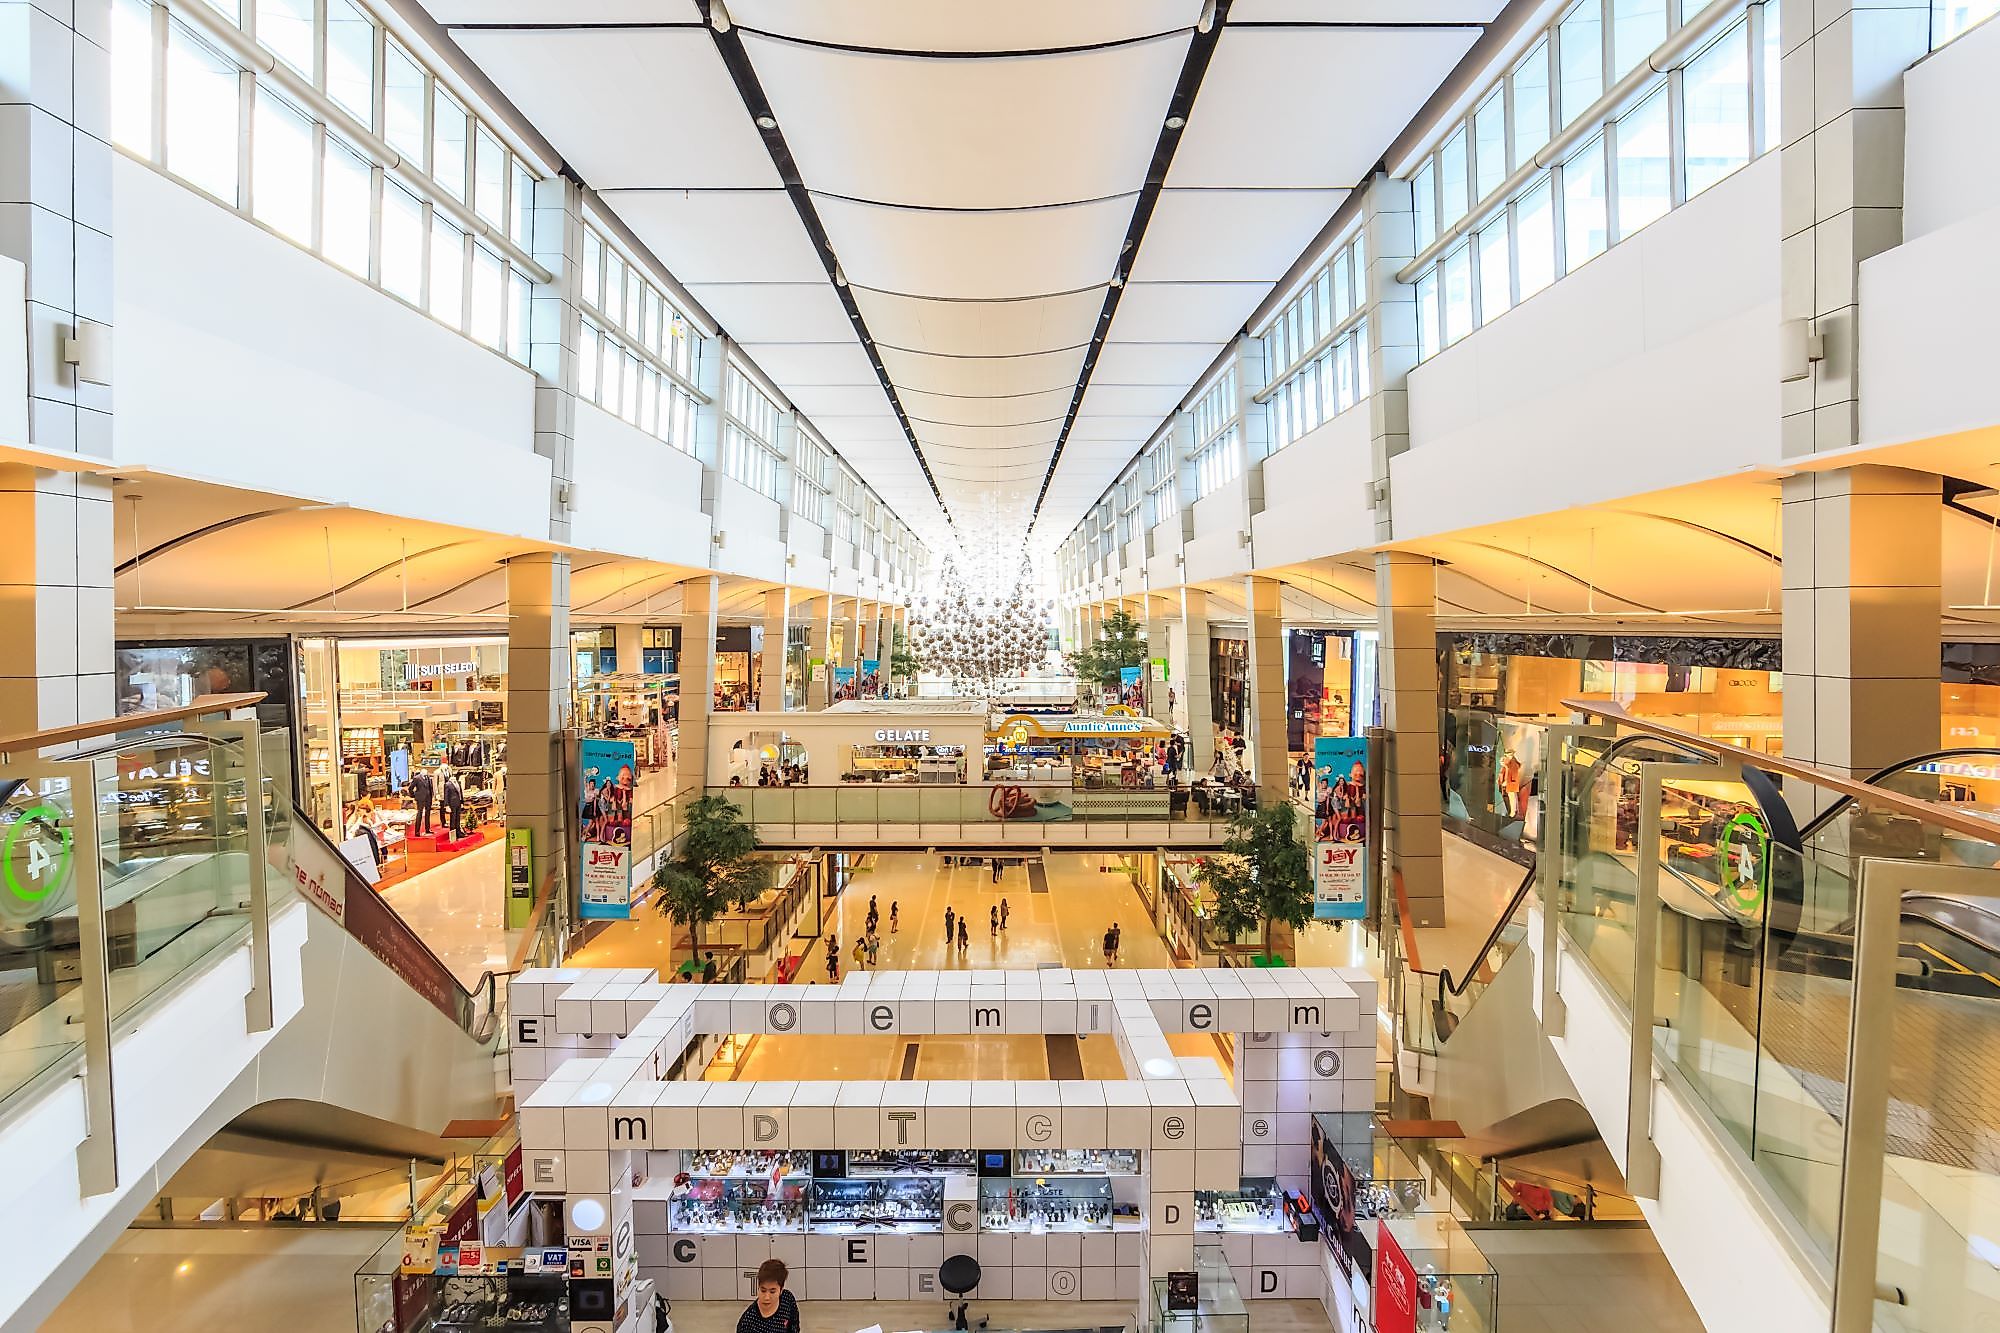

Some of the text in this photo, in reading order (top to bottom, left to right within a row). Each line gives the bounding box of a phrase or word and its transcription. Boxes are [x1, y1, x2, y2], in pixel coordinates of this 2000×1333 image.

[421, 665, 443, 676] SUIT
[875, 730, 930, 741] GELATE
[1065, 721, 1141, 731] Auntie Anne's
[870, 1005, 893, 1031] e
[976, 1007, 1001, 1027] m
[1190, 1004, 1212, 1029] e
[1294, 1005, 1319, 1024] m
[519, 1020, 538, 1043] E
[614, 1115, 647, 1140] m
[754, 1115, 778, 1141] D
[888, 1112, 917, 1144] T
[1163, 1116, 1184, 1139] e
[1252, 1119, 1268, 1136] e
[534, 1158, 554, 1182] E
[1165, 1205, 1179, 1223] D
[571, 1238, 592, 1246] VISA
[847, 1240, 867, 1262] E
[547, 1253, 564, 1261] VAT
[919, 1274, 934, 1292] E
[1261, 1270, 1277, 1293] D
